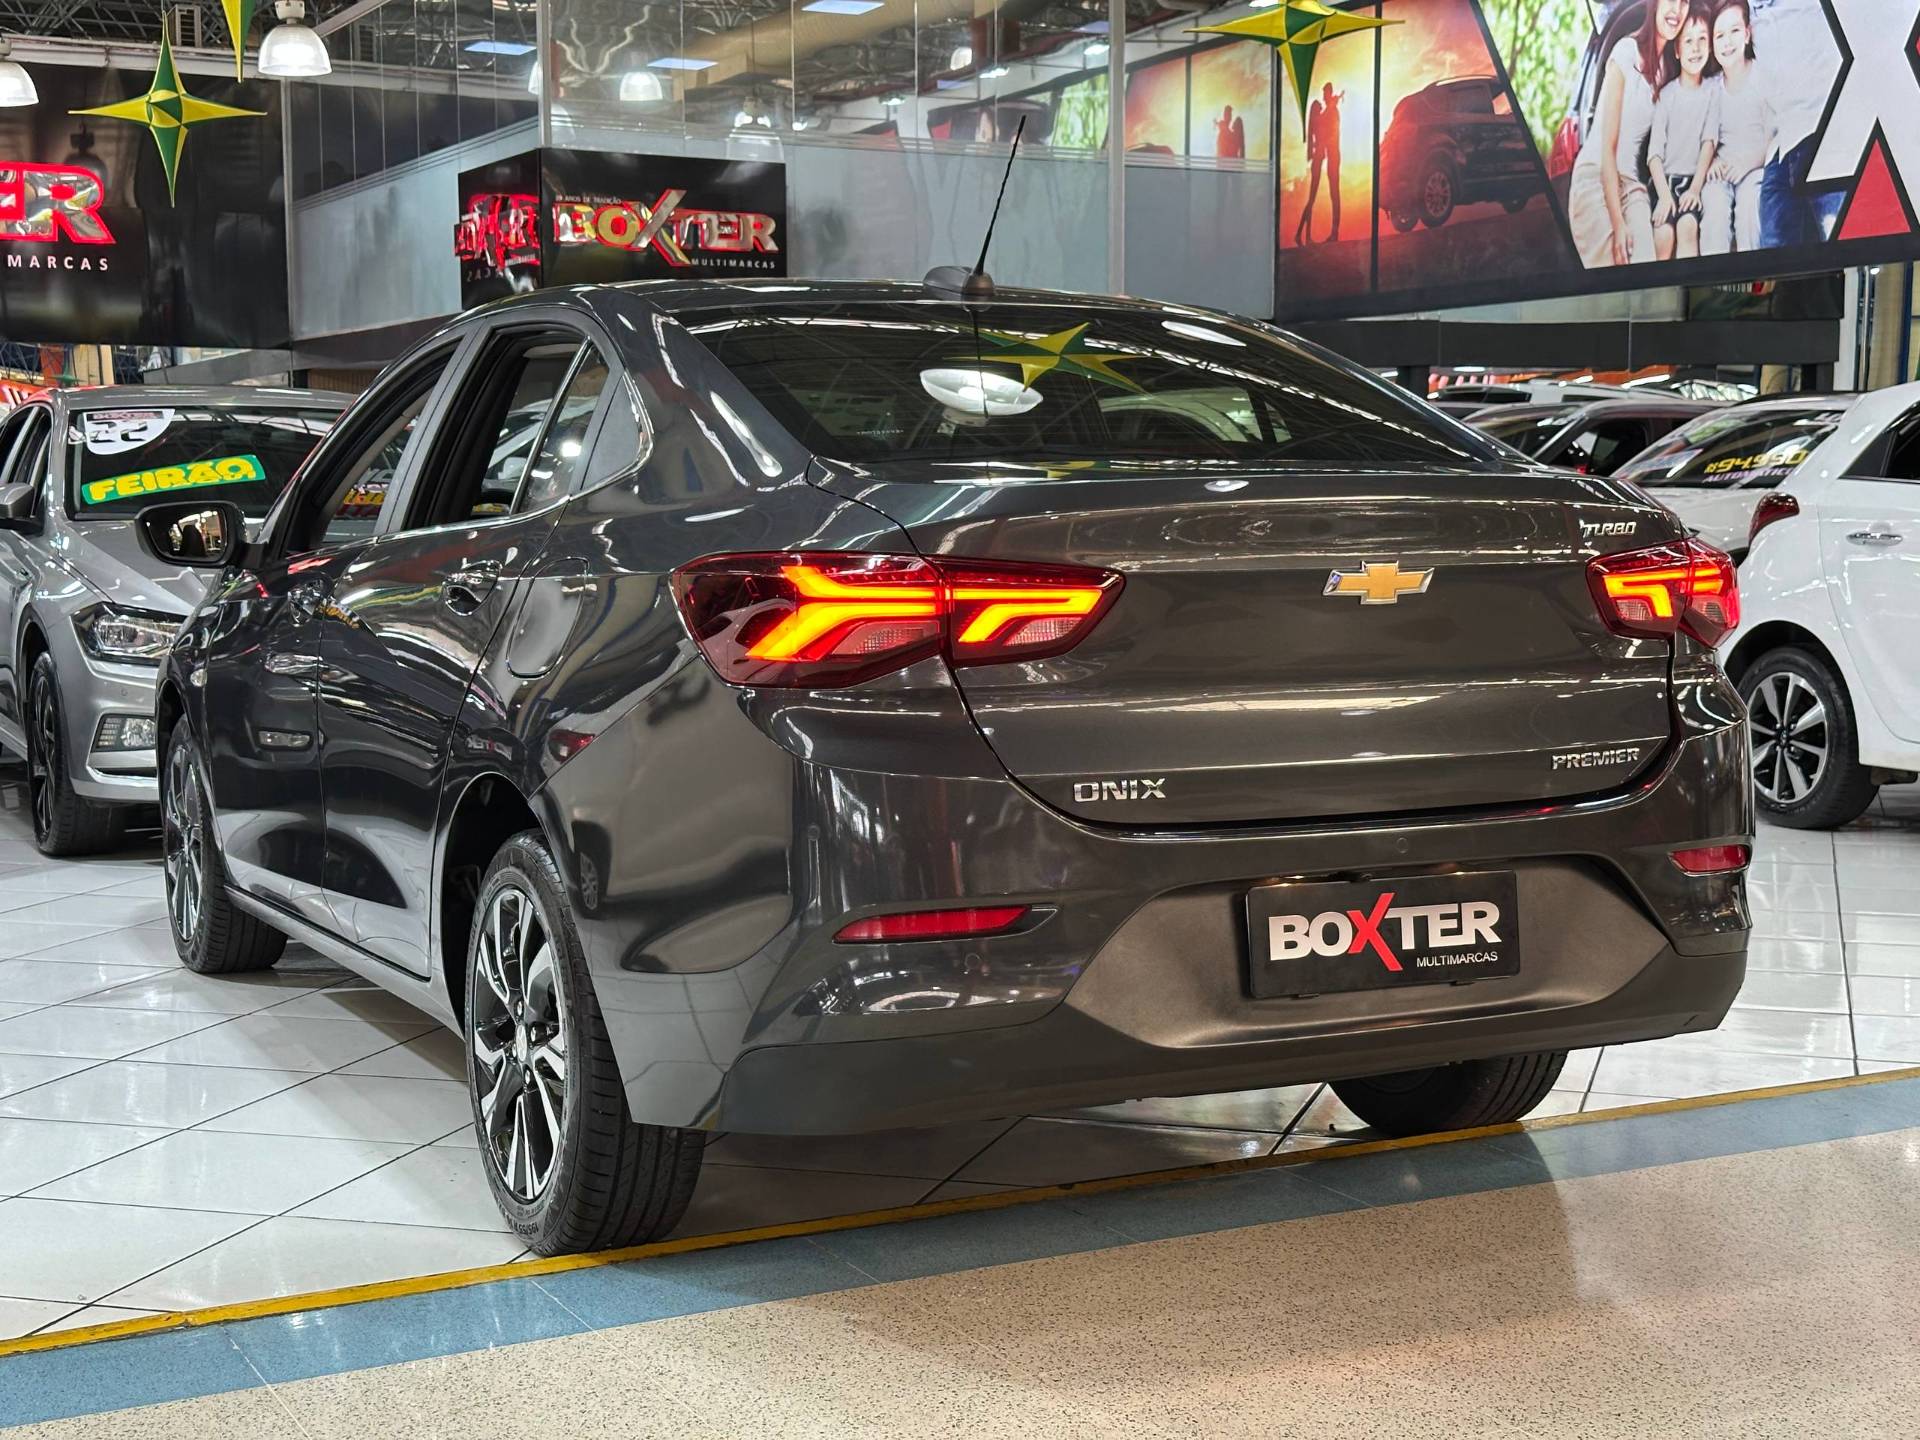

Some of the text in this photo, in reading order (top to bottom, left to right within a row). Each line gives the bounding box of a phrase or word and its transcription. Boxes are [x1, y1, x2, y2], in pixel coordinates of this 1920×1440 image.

[552, 188, 779, 267] BOXTER
[691, 258, 776, 269] MULTIMARCAS
[89, 456, 257, 501] FEIRÃO
[1582, 521, 1637, 538] TURBO
[1551, 747, 1640, 770] PREMIER
[1073, 778, 1166, 802] ONIX
[1268, 892, 1502, 971] BOXTER
[1416, 951, 1499, 968] MULTIMARCAS
